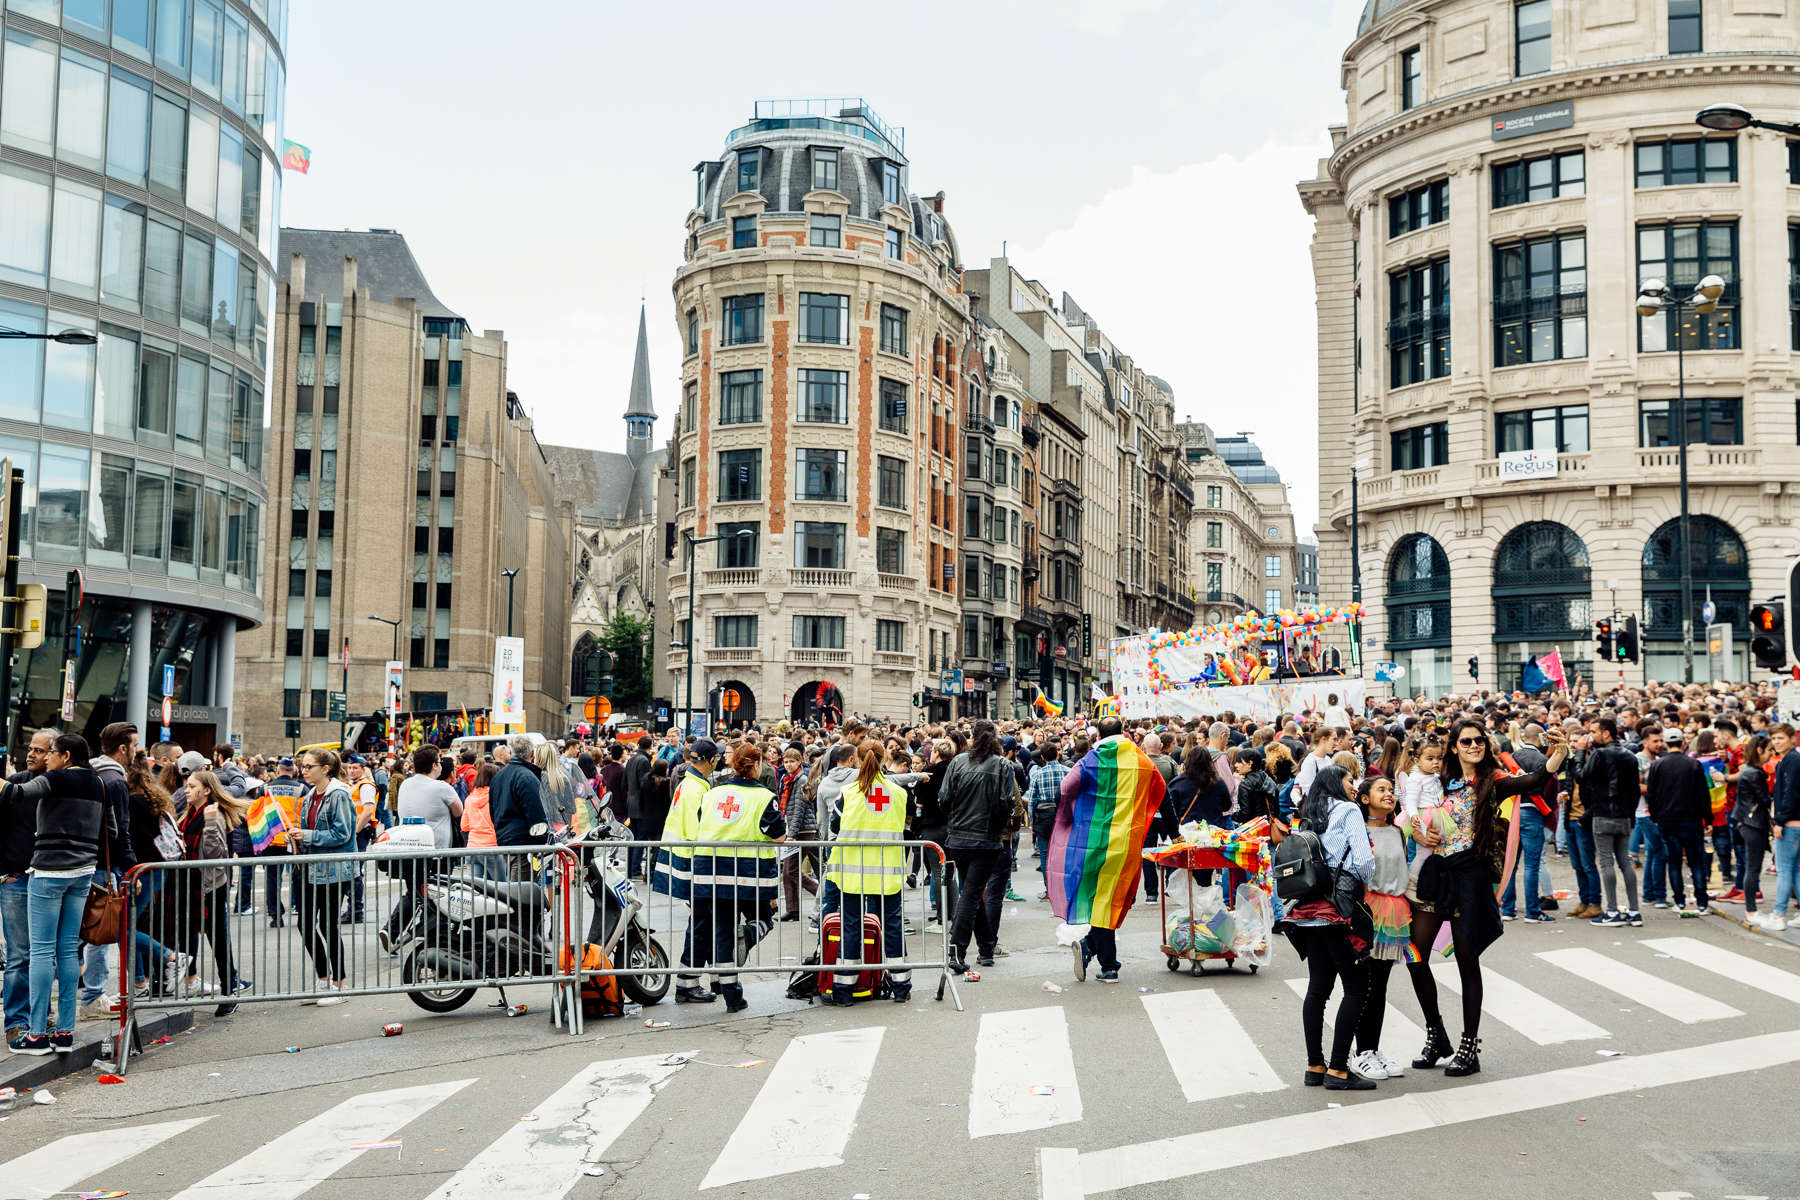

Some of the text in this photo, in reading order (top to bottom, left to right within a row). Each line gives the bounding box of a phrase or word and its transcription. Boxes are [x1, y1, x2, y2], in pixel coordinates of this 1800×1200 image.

[1505, 109, 1570, 126] SOCIETE GENERALE
[1504, 460, 1554, 475] Regus
[184, 707, 209, 721] plaza
